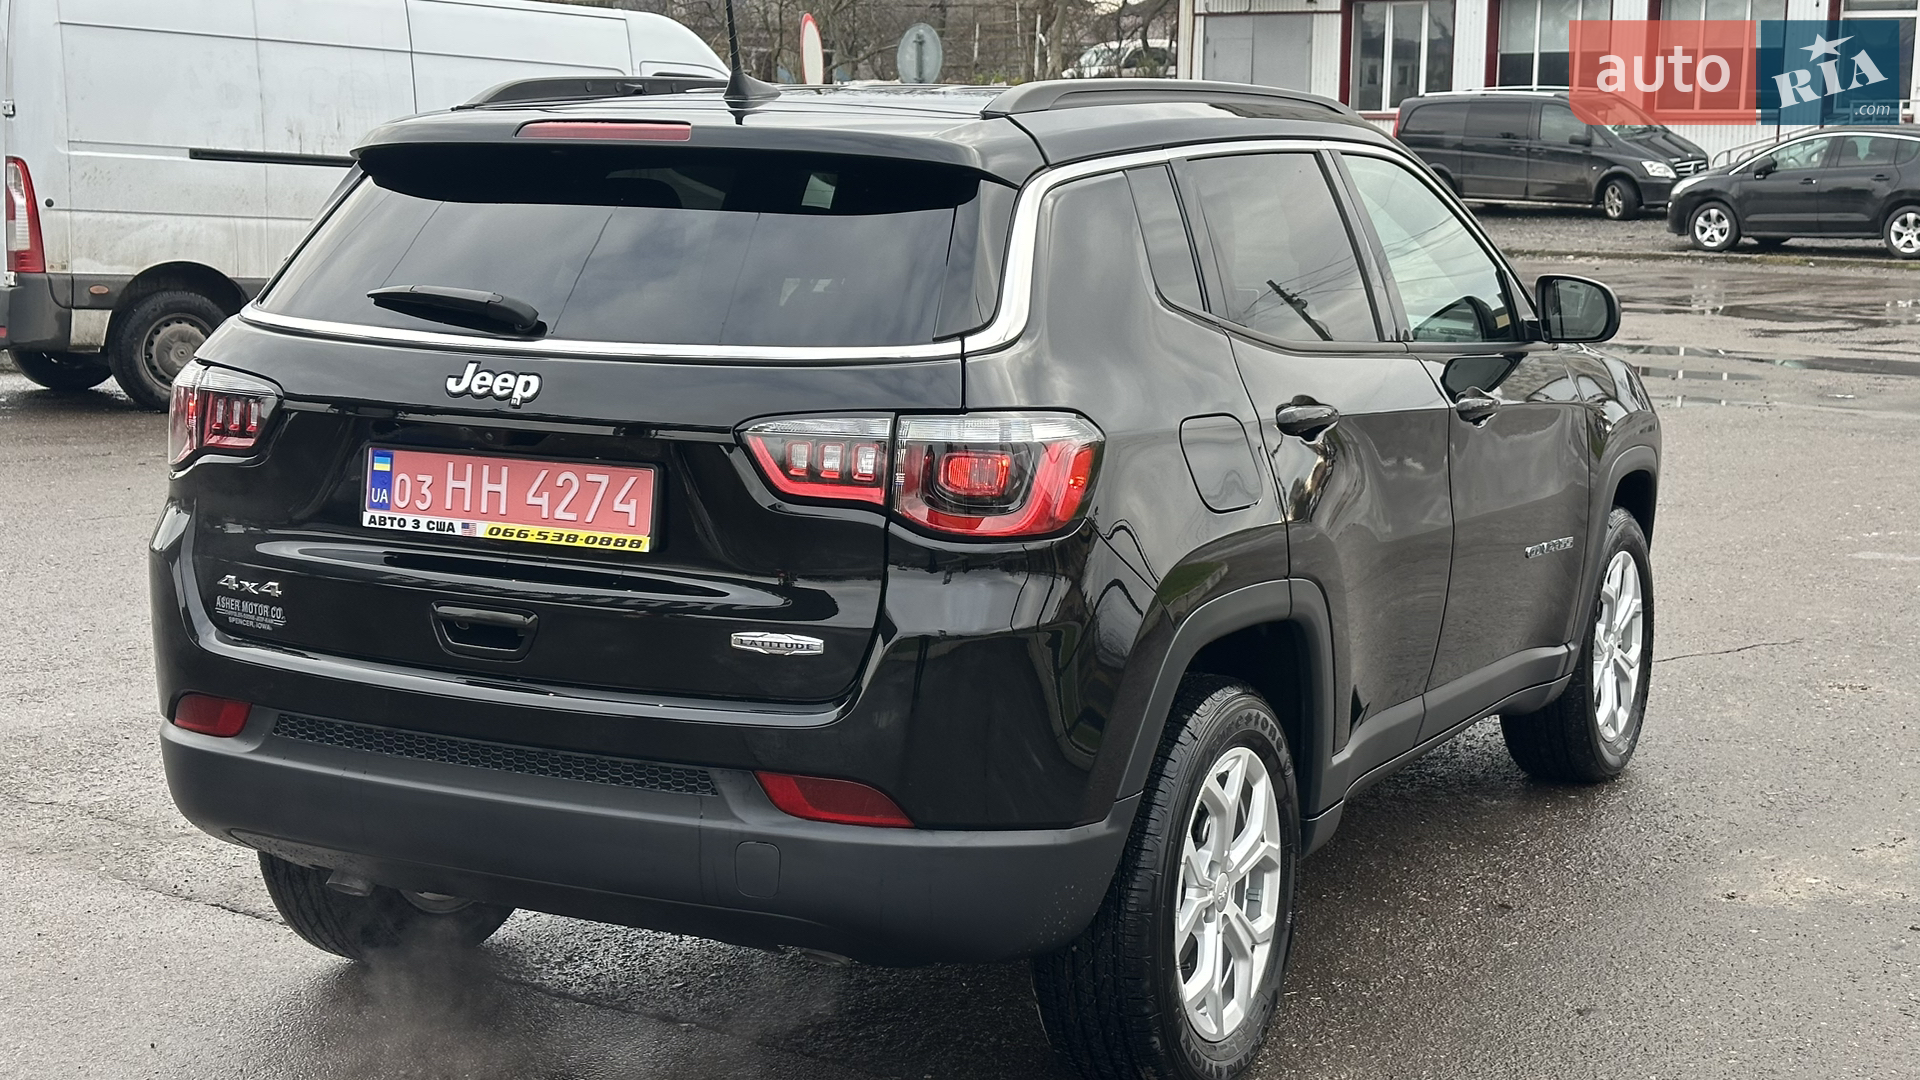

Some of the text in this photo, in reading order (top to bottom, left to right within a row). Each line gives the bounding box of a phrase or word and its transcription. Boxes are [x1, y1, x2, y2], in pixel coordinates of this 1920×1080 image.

[445, 361, 541, 407] Jeep
[371, 487, 389, 504] UA
[393, 461, 638, 527] 03 HH 4274
[367, 514, 405, 529] АВТО
[427, 519, 456, 534] США
[487, 526, 643, 550] 066-538-0888
[216, 595, 240, 611] ASHER
[241, 600, 270, 617] MOTOR
[738, 638, 814, 650] LATITUDE
